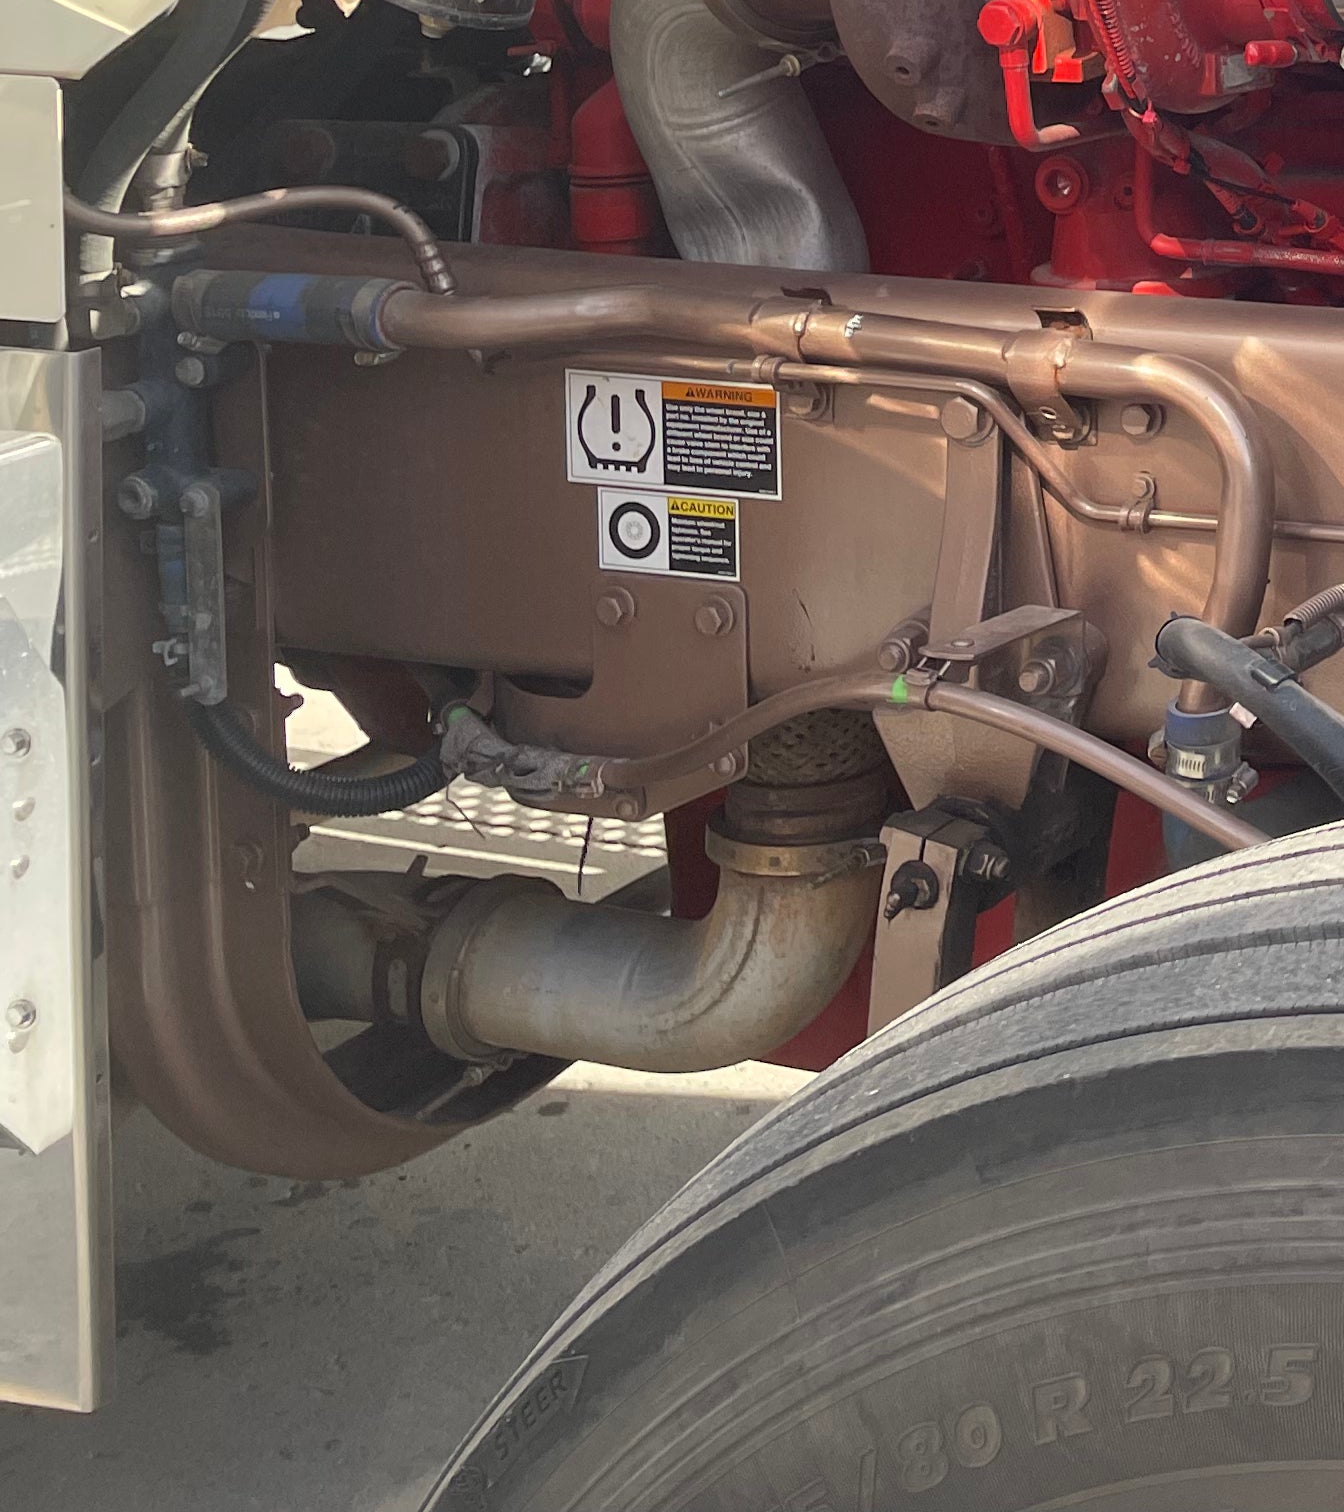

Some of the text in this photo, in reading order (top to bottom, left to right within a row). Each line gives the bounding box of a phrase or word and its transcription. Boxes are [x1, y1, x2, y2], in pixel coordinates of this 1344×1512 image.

[696, 388, 752, 402] WARNING
[681, 501, 734, 516] CAUTION
[1032, 1371, 1094, 1444] R
[1125, 1342, 1321, 1424] 22.5
